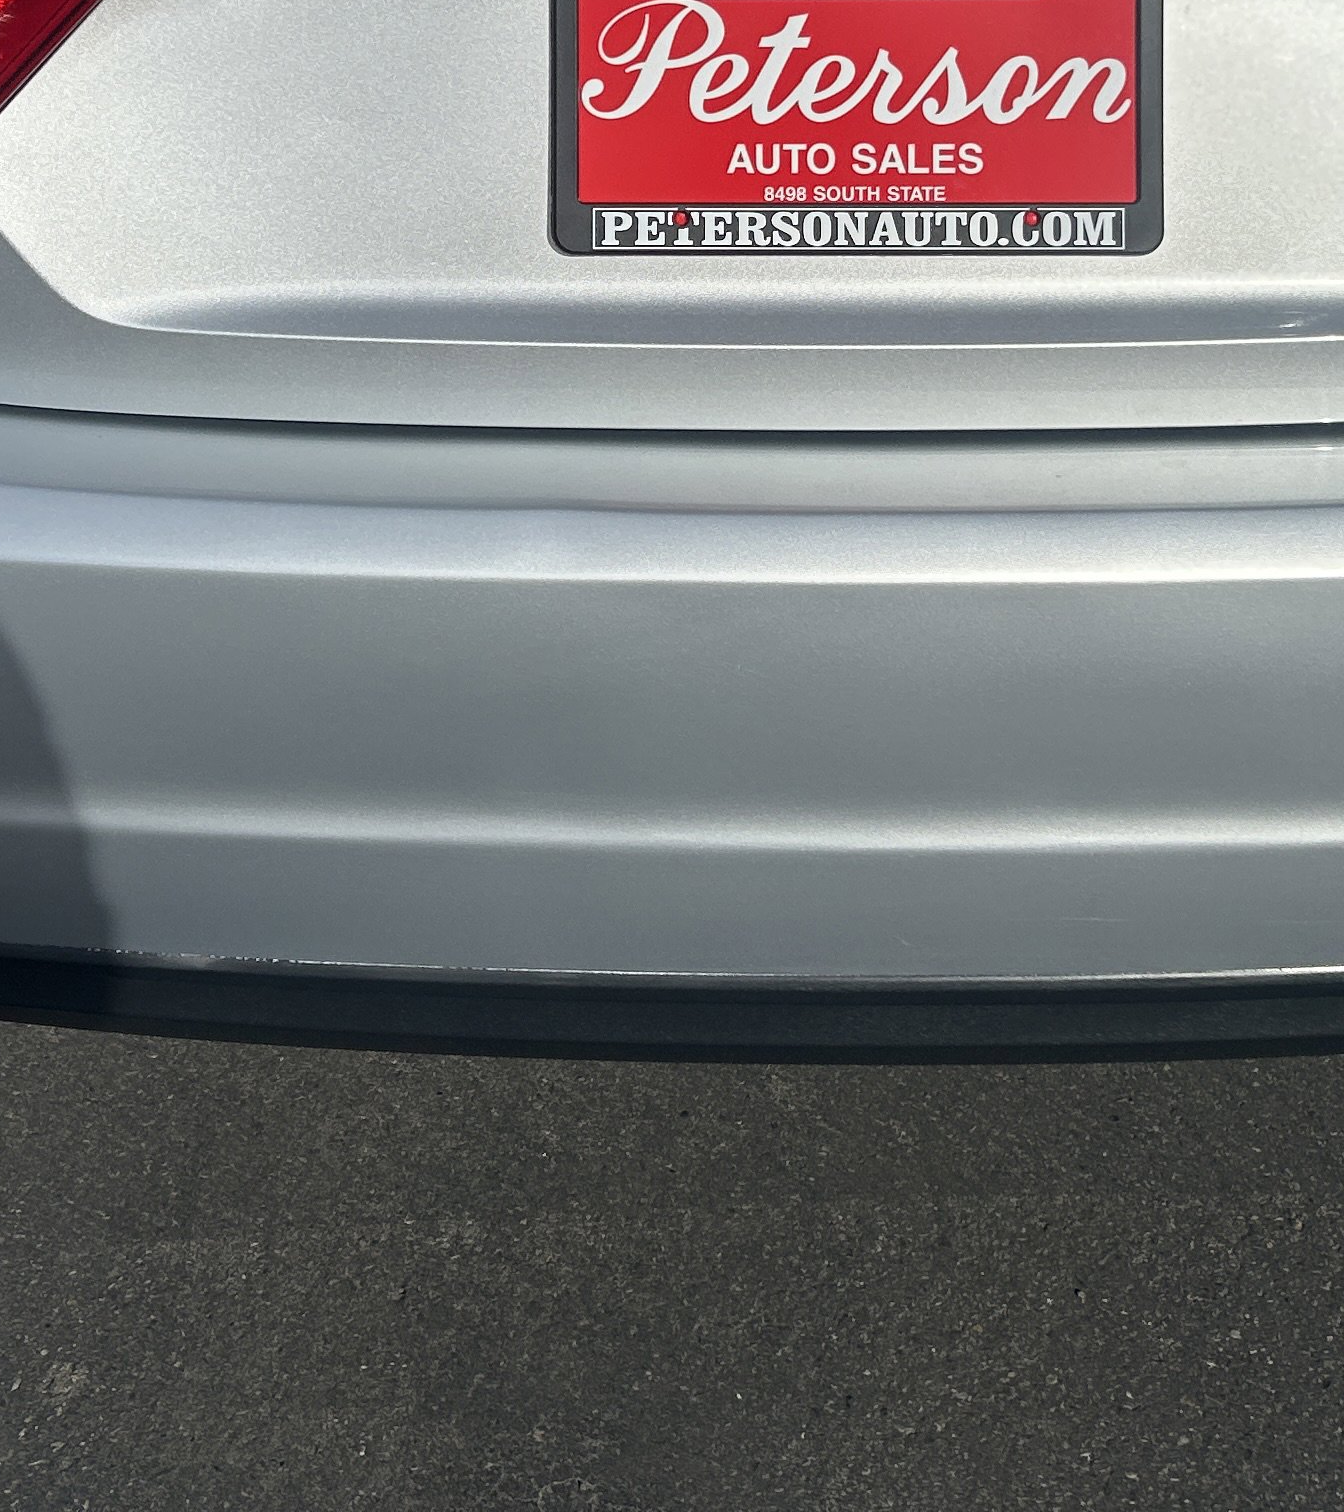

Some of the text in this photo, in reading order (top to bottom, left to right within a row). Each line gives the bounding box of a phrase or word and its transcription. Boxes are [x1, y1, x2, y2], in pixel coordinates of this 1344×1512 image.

[727, 142, 984, 175] AUTO SALES
[763, 186, 946, 202] 8498 SOUTH STATE
[601, 211, 1116, 246] PETERSONAUTO.COM
